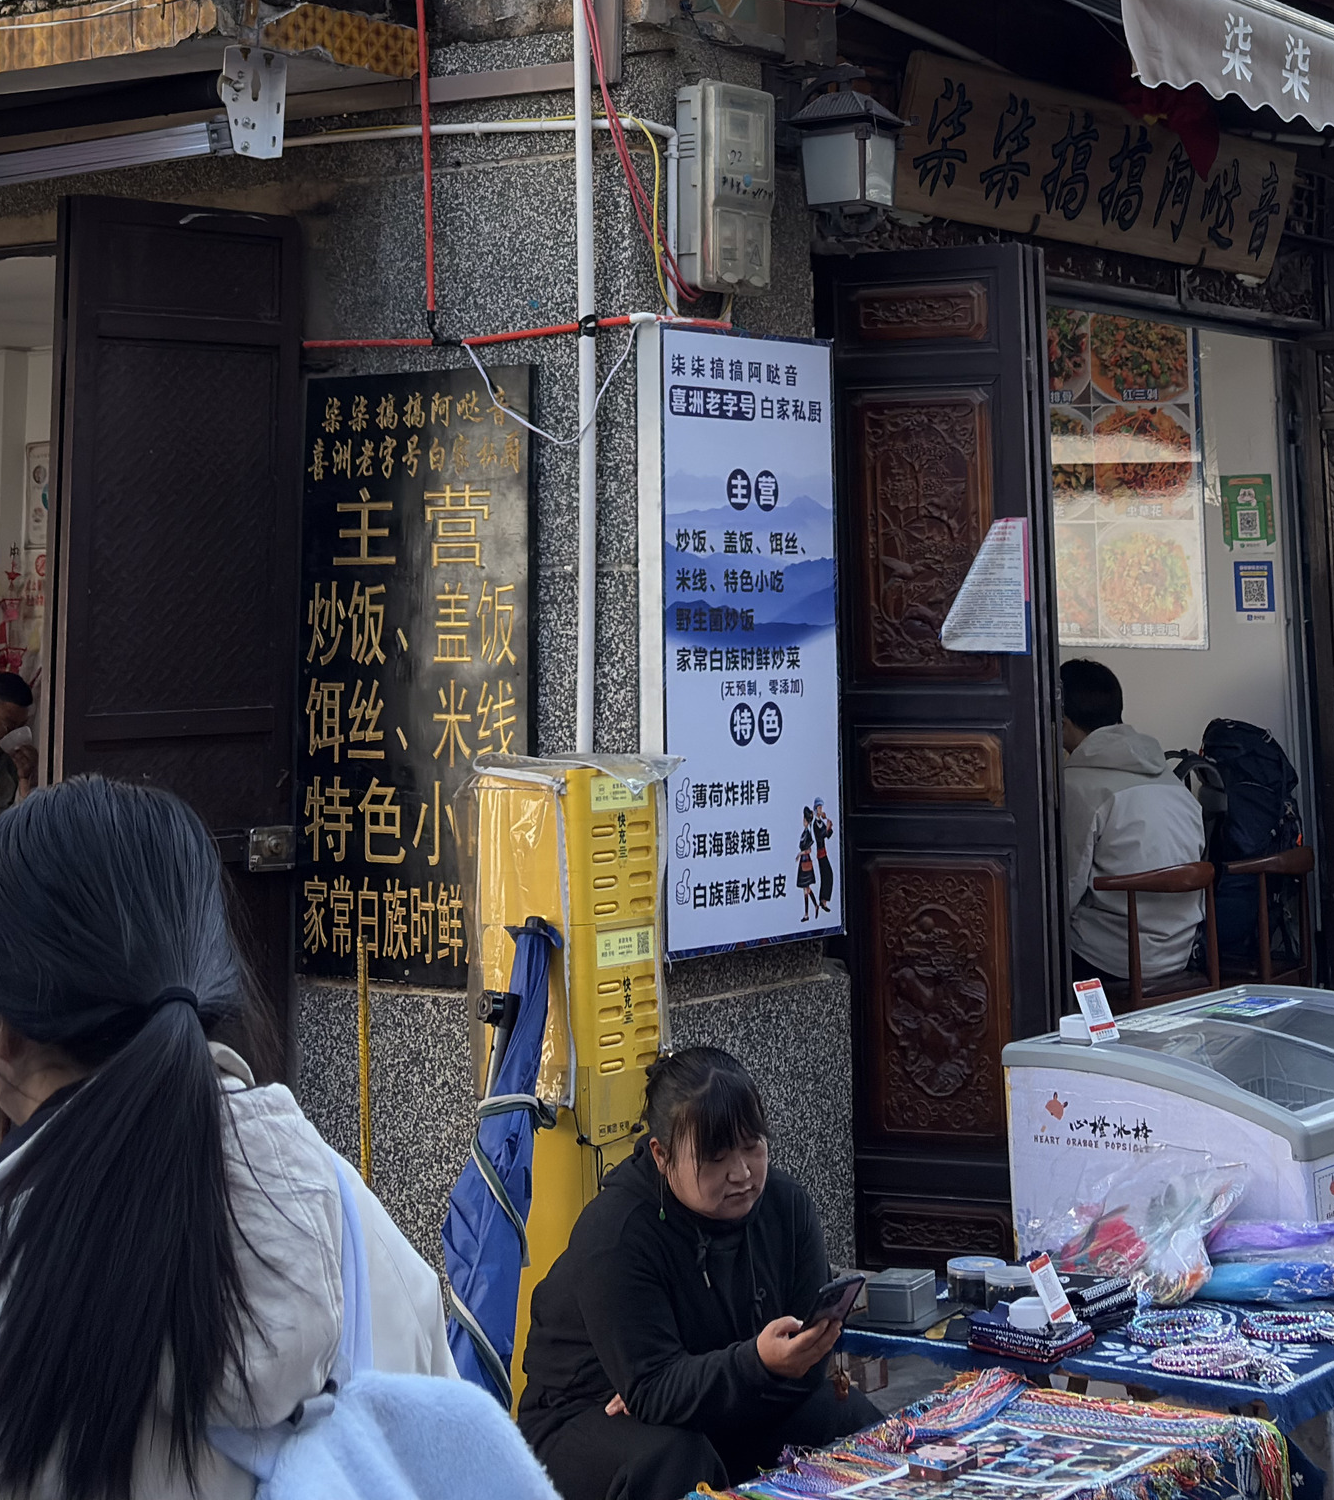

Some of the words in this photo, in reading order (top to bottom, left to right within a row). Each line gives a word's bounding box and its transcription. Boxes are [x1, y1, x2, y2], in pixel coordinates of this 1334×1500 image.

[670, 353, 798, 387] 柒柒搞搞阿哒音
[321, 385, 509, 434] 柒柒搞搞阿哒音
[670, 387, 755, 420] 喜洲老字号
[760, 398, 822, 423] 白家私厨
[730, 475, 777, 507] 主营
[332, 485, 492, 568] 主营
[675, 568, 785, 594] 米线、特色小吃
[675, 608, 755, 633] 野生菌炒饭
[676, 646, 801, 673] 家常白族时鲜炒菜
[733, 707, 781, 741] 特色
[692, 779, 770, 810] 薄荷炸排骨
[692, 827, 771, 859] 洱海酸辣鱼
[692, 873, 787, 910] 白族蘸水生皮
[304, 875, 470, 967] 家常白族时鲜
